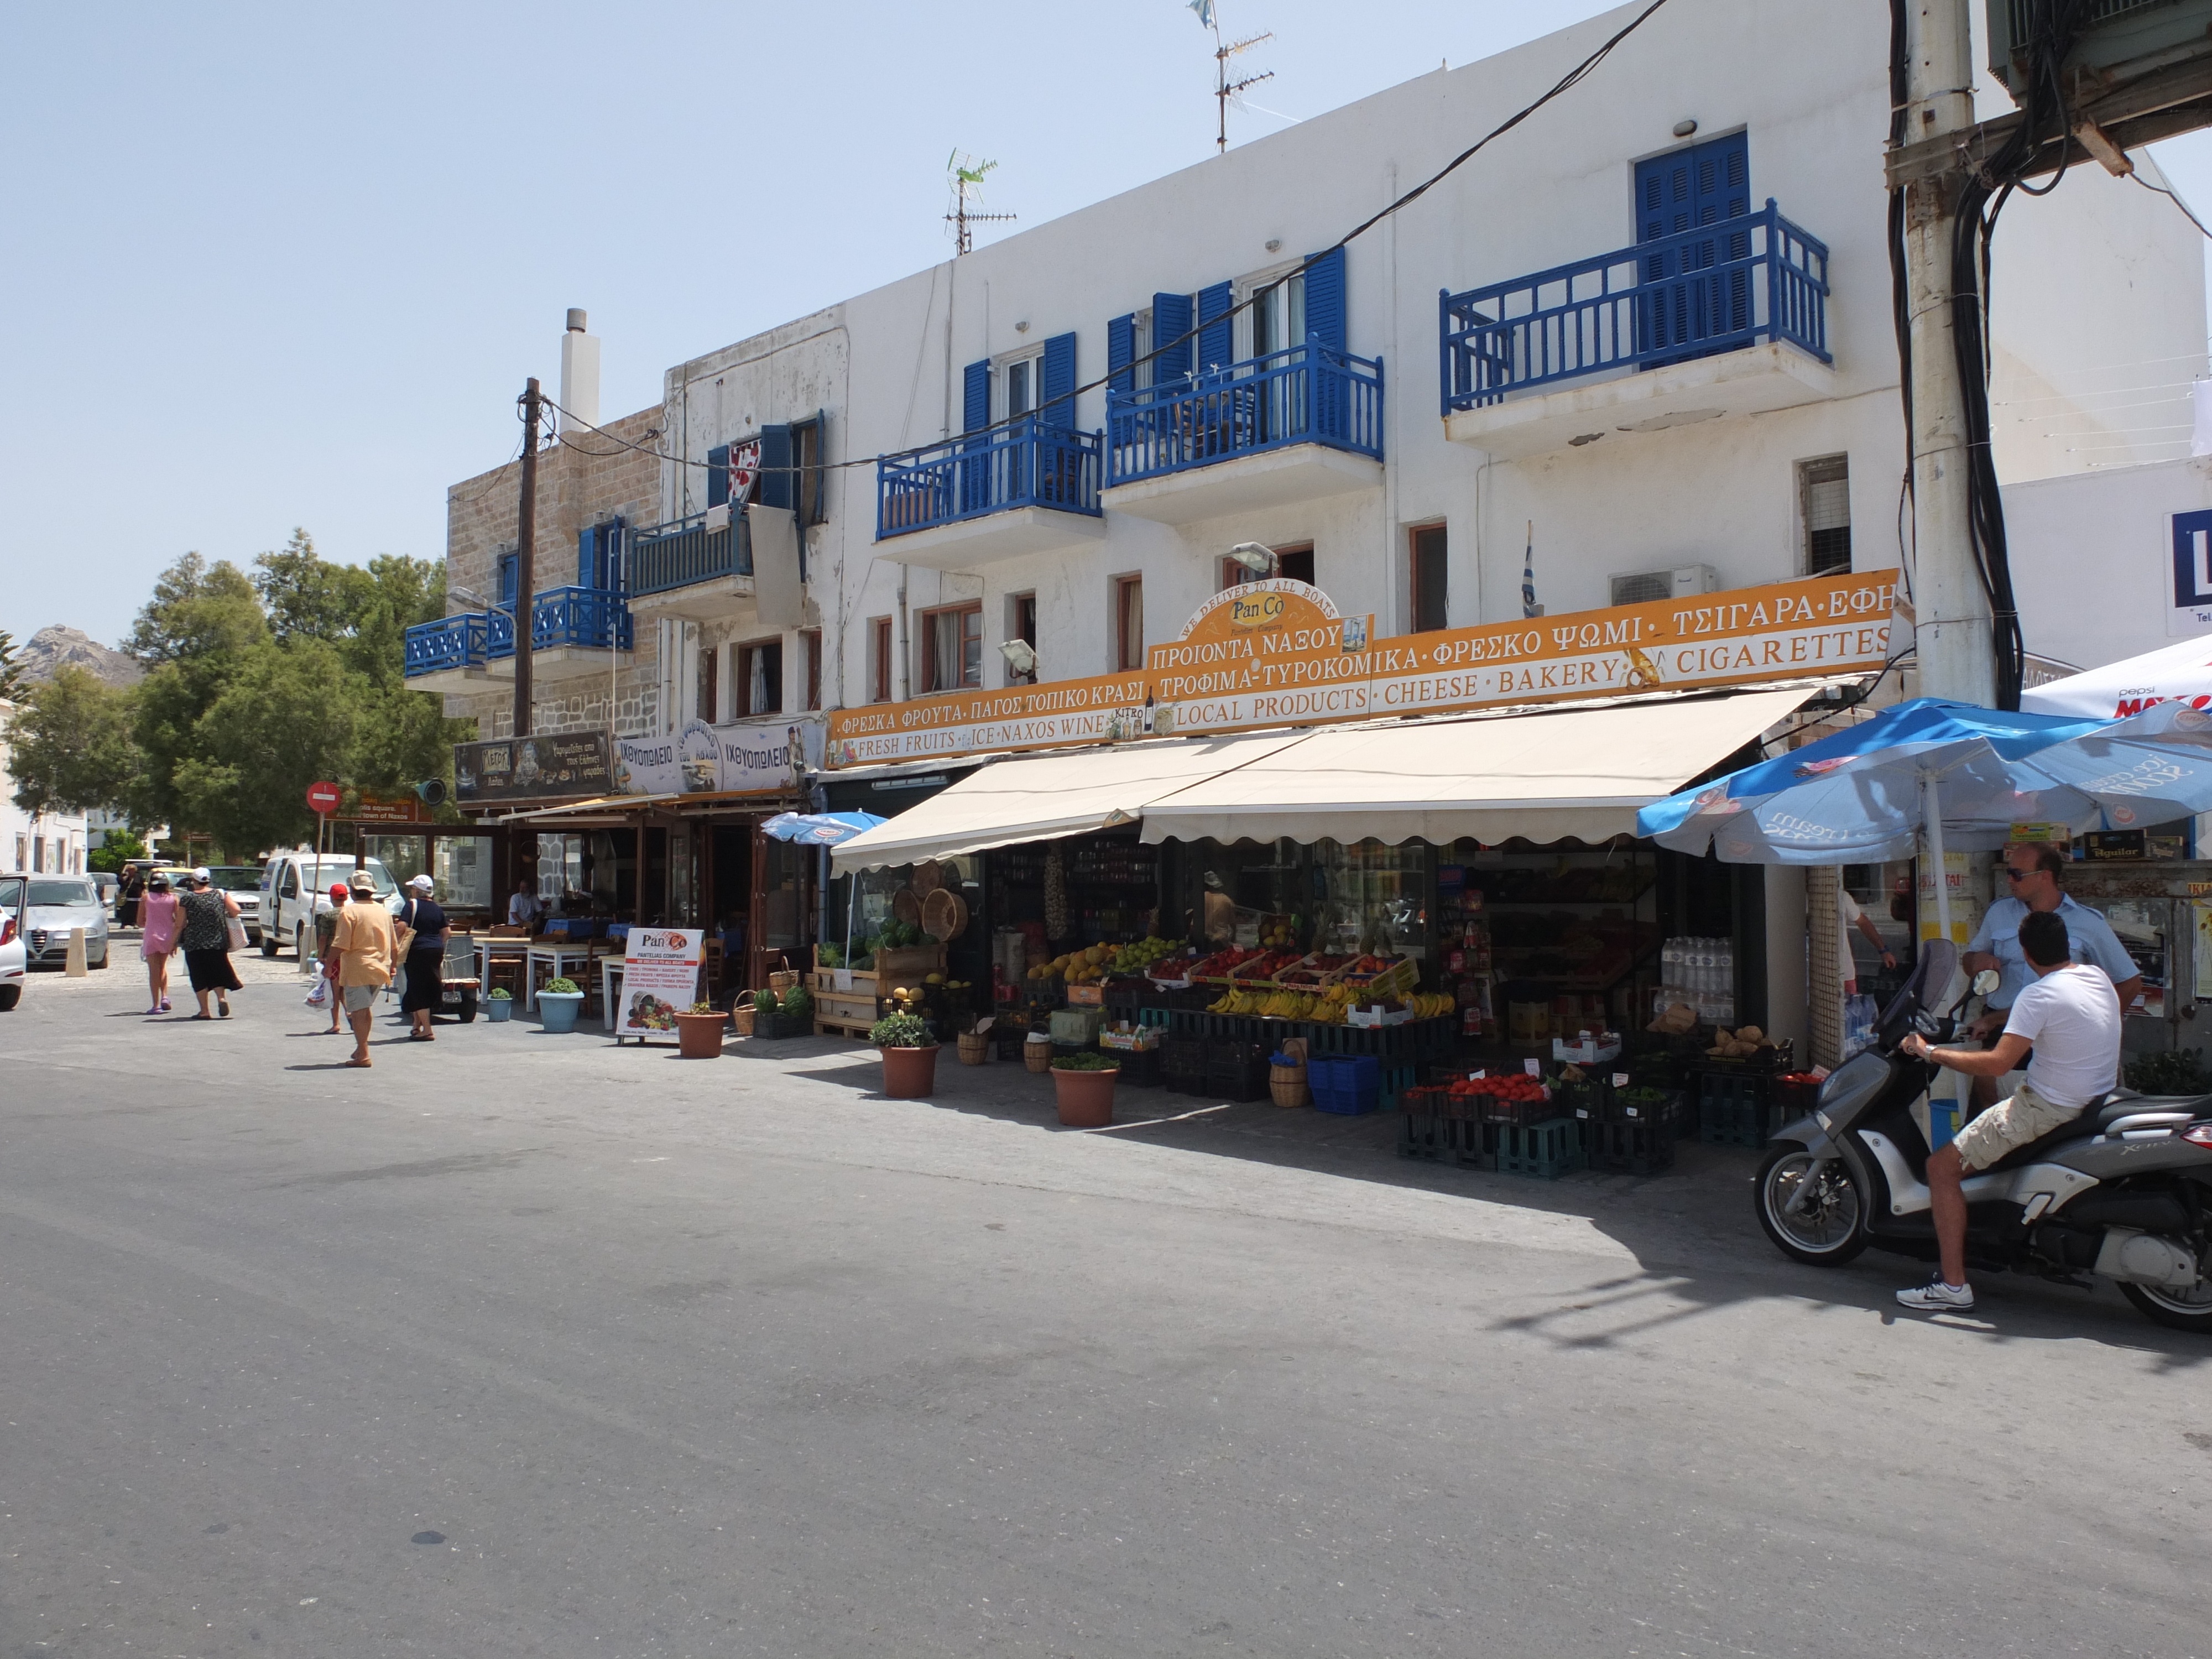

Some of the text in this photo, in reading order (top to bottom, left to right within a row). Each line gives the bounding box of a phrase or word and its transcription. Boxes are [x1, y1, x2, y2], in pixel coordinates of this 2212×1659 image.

[1181, 580, 1336, 638] WE DELIVER TO ALL BOATS
[1233, 596, 1285, 620] Pan Co
[1262, 625, 1341, 655] ΝΑΞΟΥ
[1432, 630, 1542, 665] ΦΡΕΣΚΟ
[1552, 617, 1642, 651] ΨΩΜΙ
[1673, 595, 1815, 636] ΤΣΙΓΑΡΑ
[1176, 627, 1891, 726] LOCAL PRODUCTS CHEESE BAKERY CIGARETTES
[2119, 686, 2155, 698] pepsi
[842, 681, 1144, 734] ΦΡΕΣΚΑ ΦΡΟΥΤΑ ΠΑΓΟΣ ΤΟΠΙΚΟ ΚΡΑΣΙ
[1115, 707, 1143, 719] KITRO
[858, 714, 1105, 757] FRESH FRUITS ICE NAXOS WINE
[641, 934, 687, 948] Pan Co
